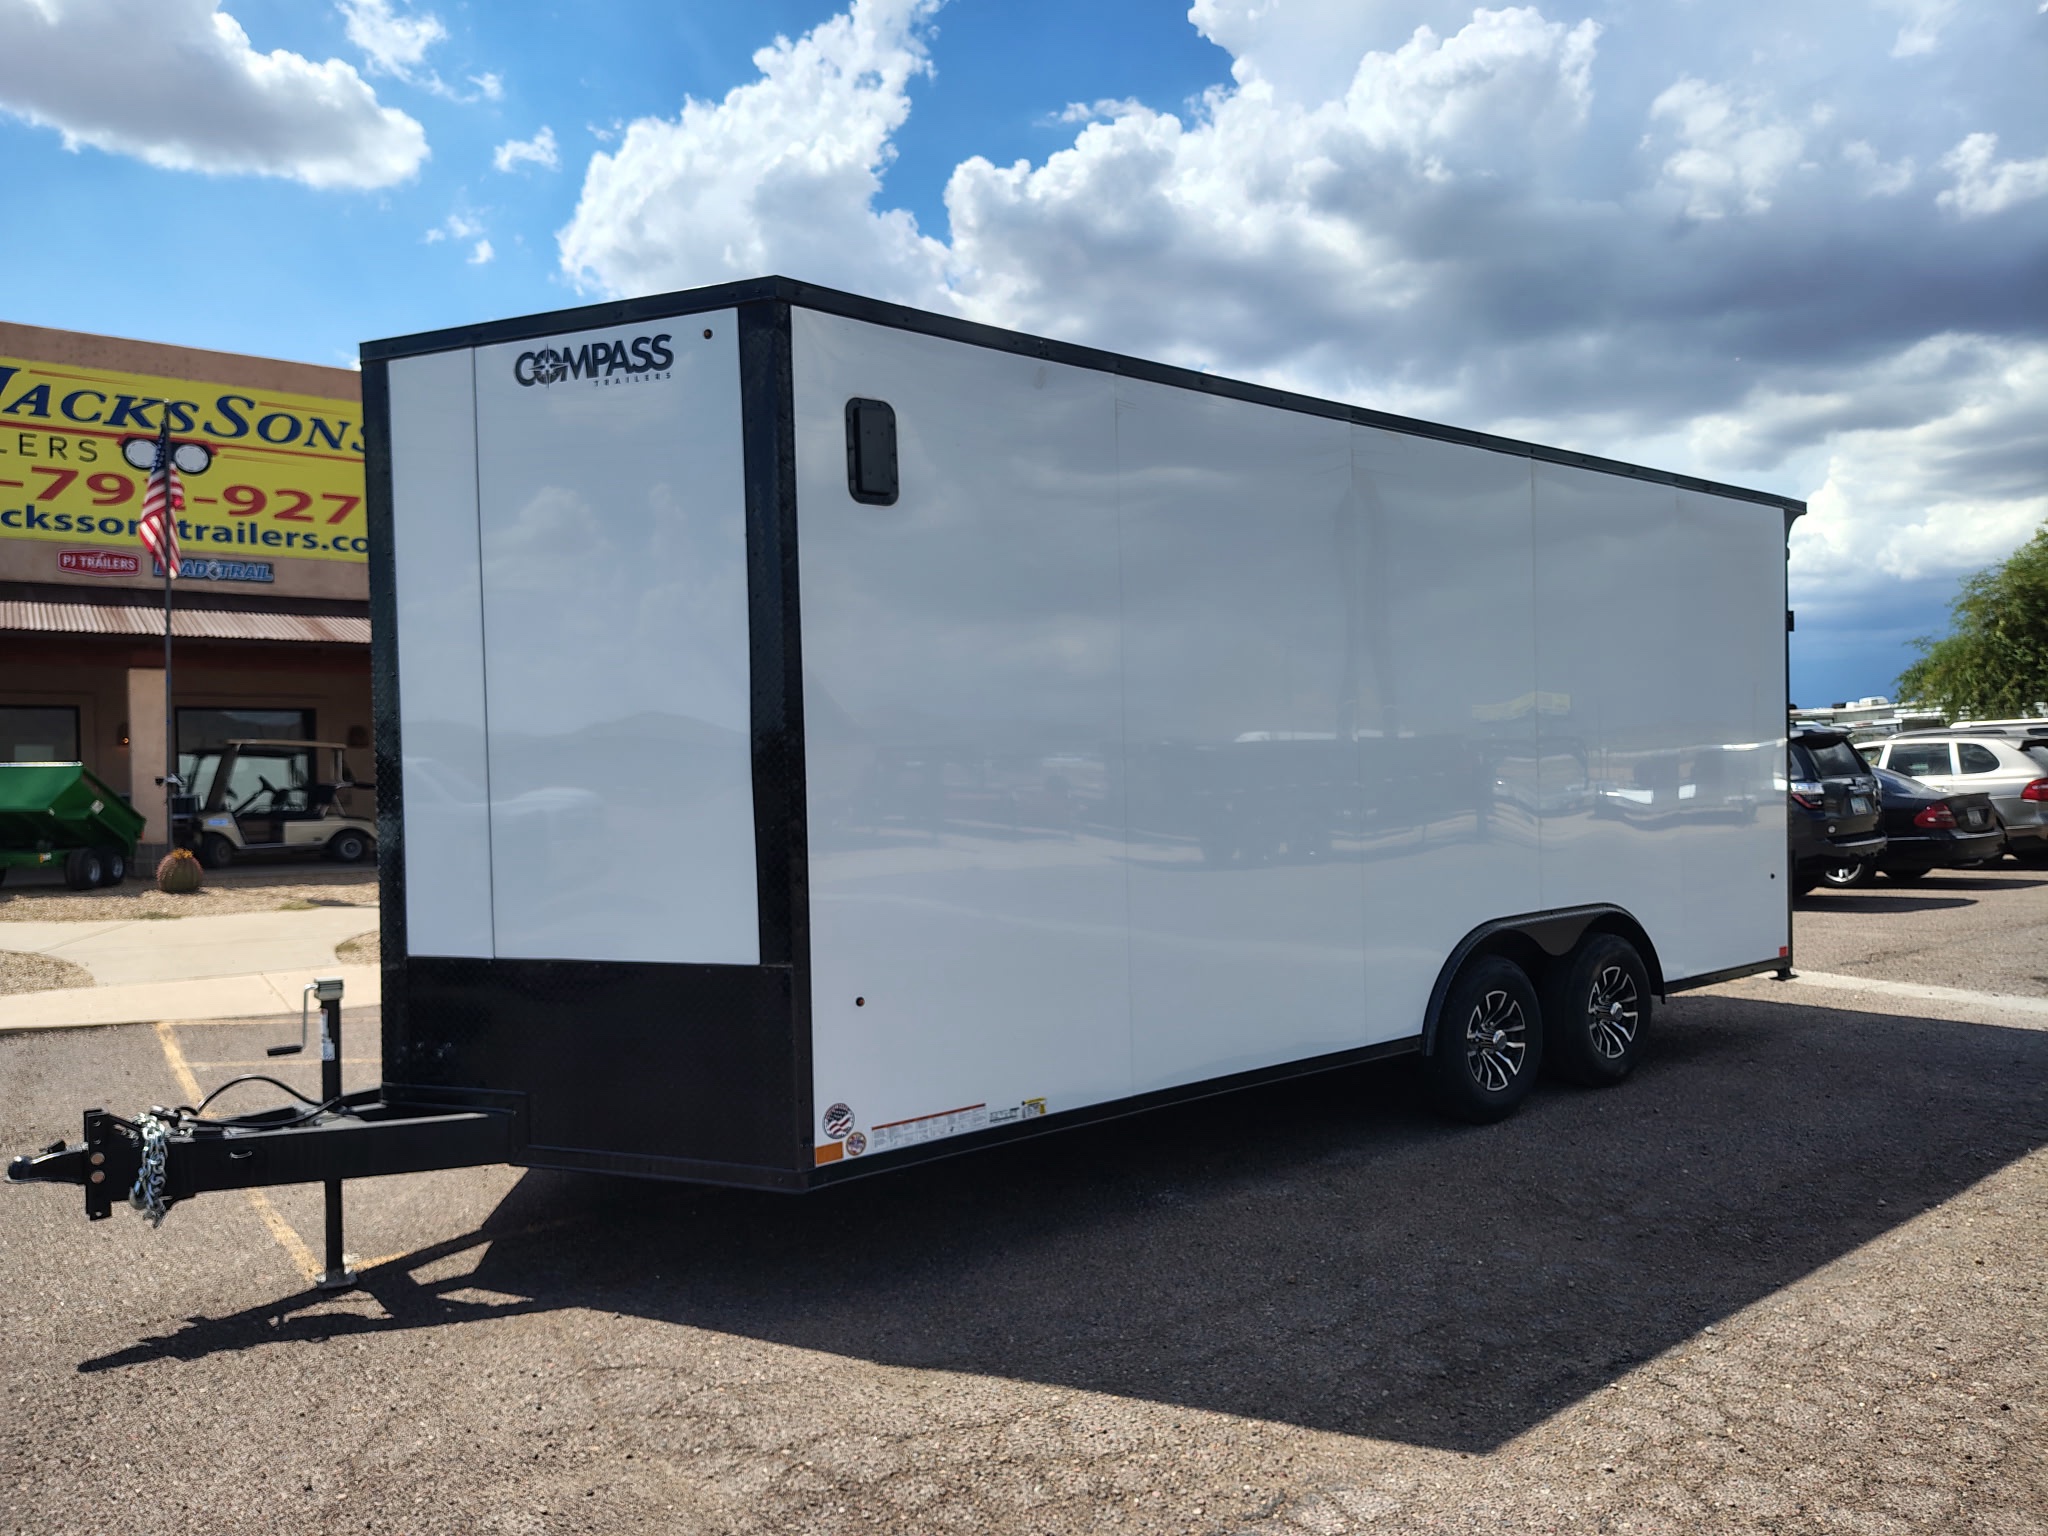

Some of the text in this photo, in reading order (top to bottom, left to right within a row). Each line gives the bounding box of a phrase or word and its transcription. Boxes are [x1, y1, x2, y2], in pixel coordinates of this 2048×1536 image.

[515, 334, 674, 388] COMPASS
[594, 372, 672, 387] TRAILERS
[0, 365, 366, 453] ACKSSON
[0, 432, 98, 463] ERS
[63, 554, 137, 571] PJ TRAILERS
[154, 560, 274, 581] LAD TRAIL
